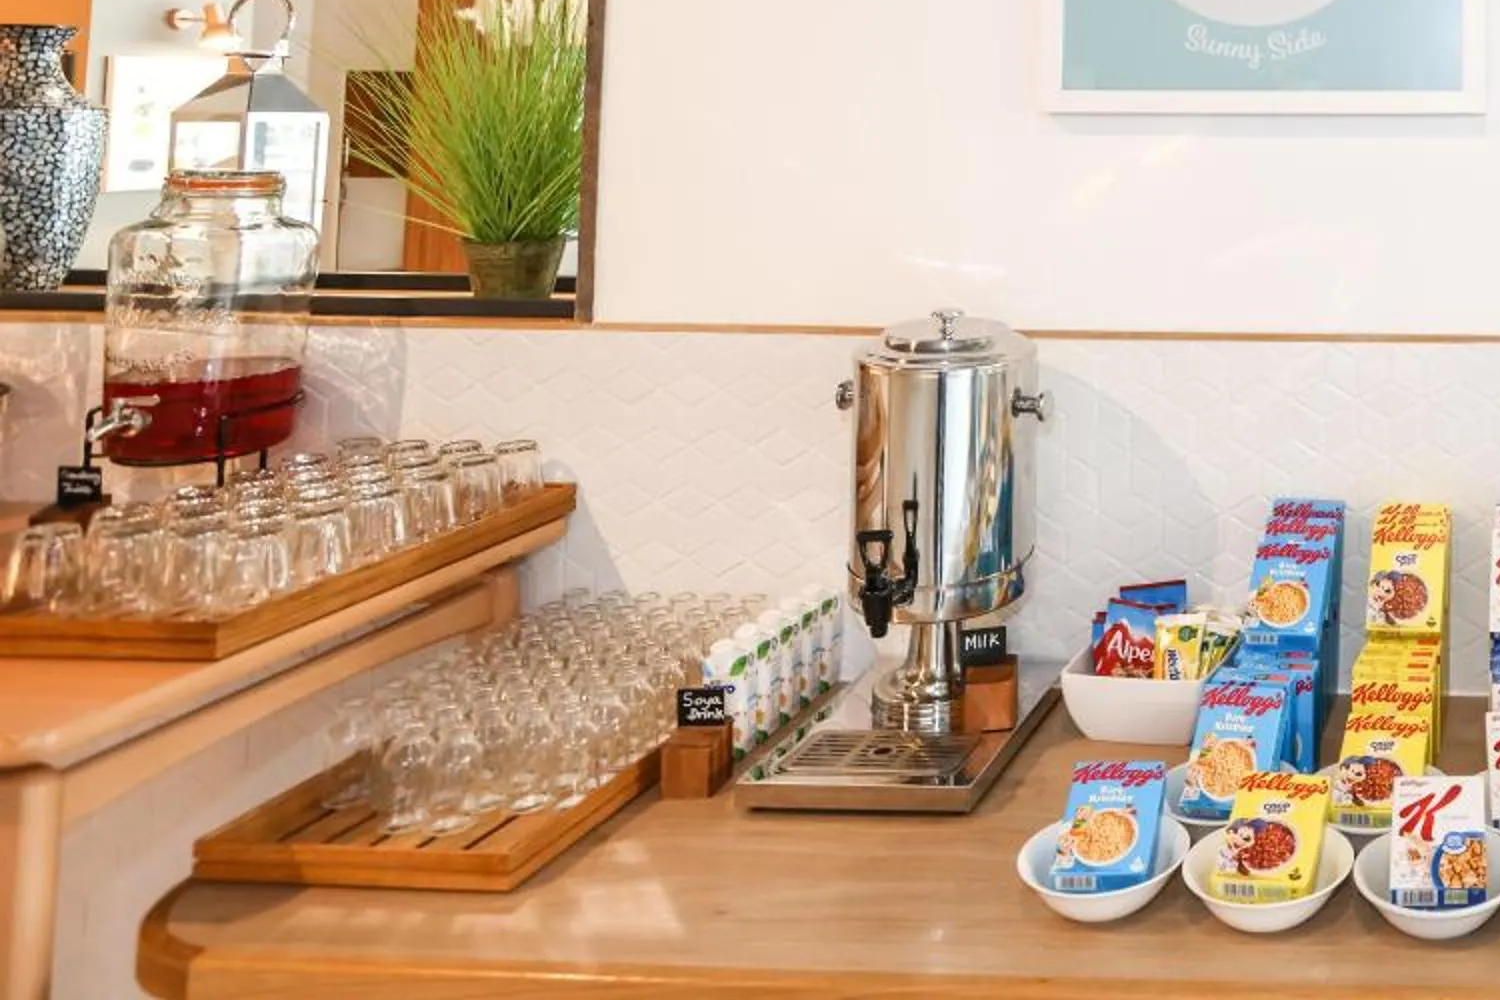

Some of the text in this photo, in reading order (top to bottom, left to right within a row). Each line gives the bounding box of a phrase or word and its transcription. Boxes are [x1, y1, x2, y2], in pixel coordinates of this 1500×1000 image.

[1184, 24, 1327, 69] Sunny Side
[1107, 629, 1155, 662] Alpe
[683, 692, 723, 707] Soya
[1352, 682, 1434, 711] Kellogg's
[1345, 713, 1429, 738] Kellogg's
[1072, 762, 1164, 787] Kellogg's
[1239, 772, 1329, 800] Kellogg's
[1399, 784, 1462, 841] K
